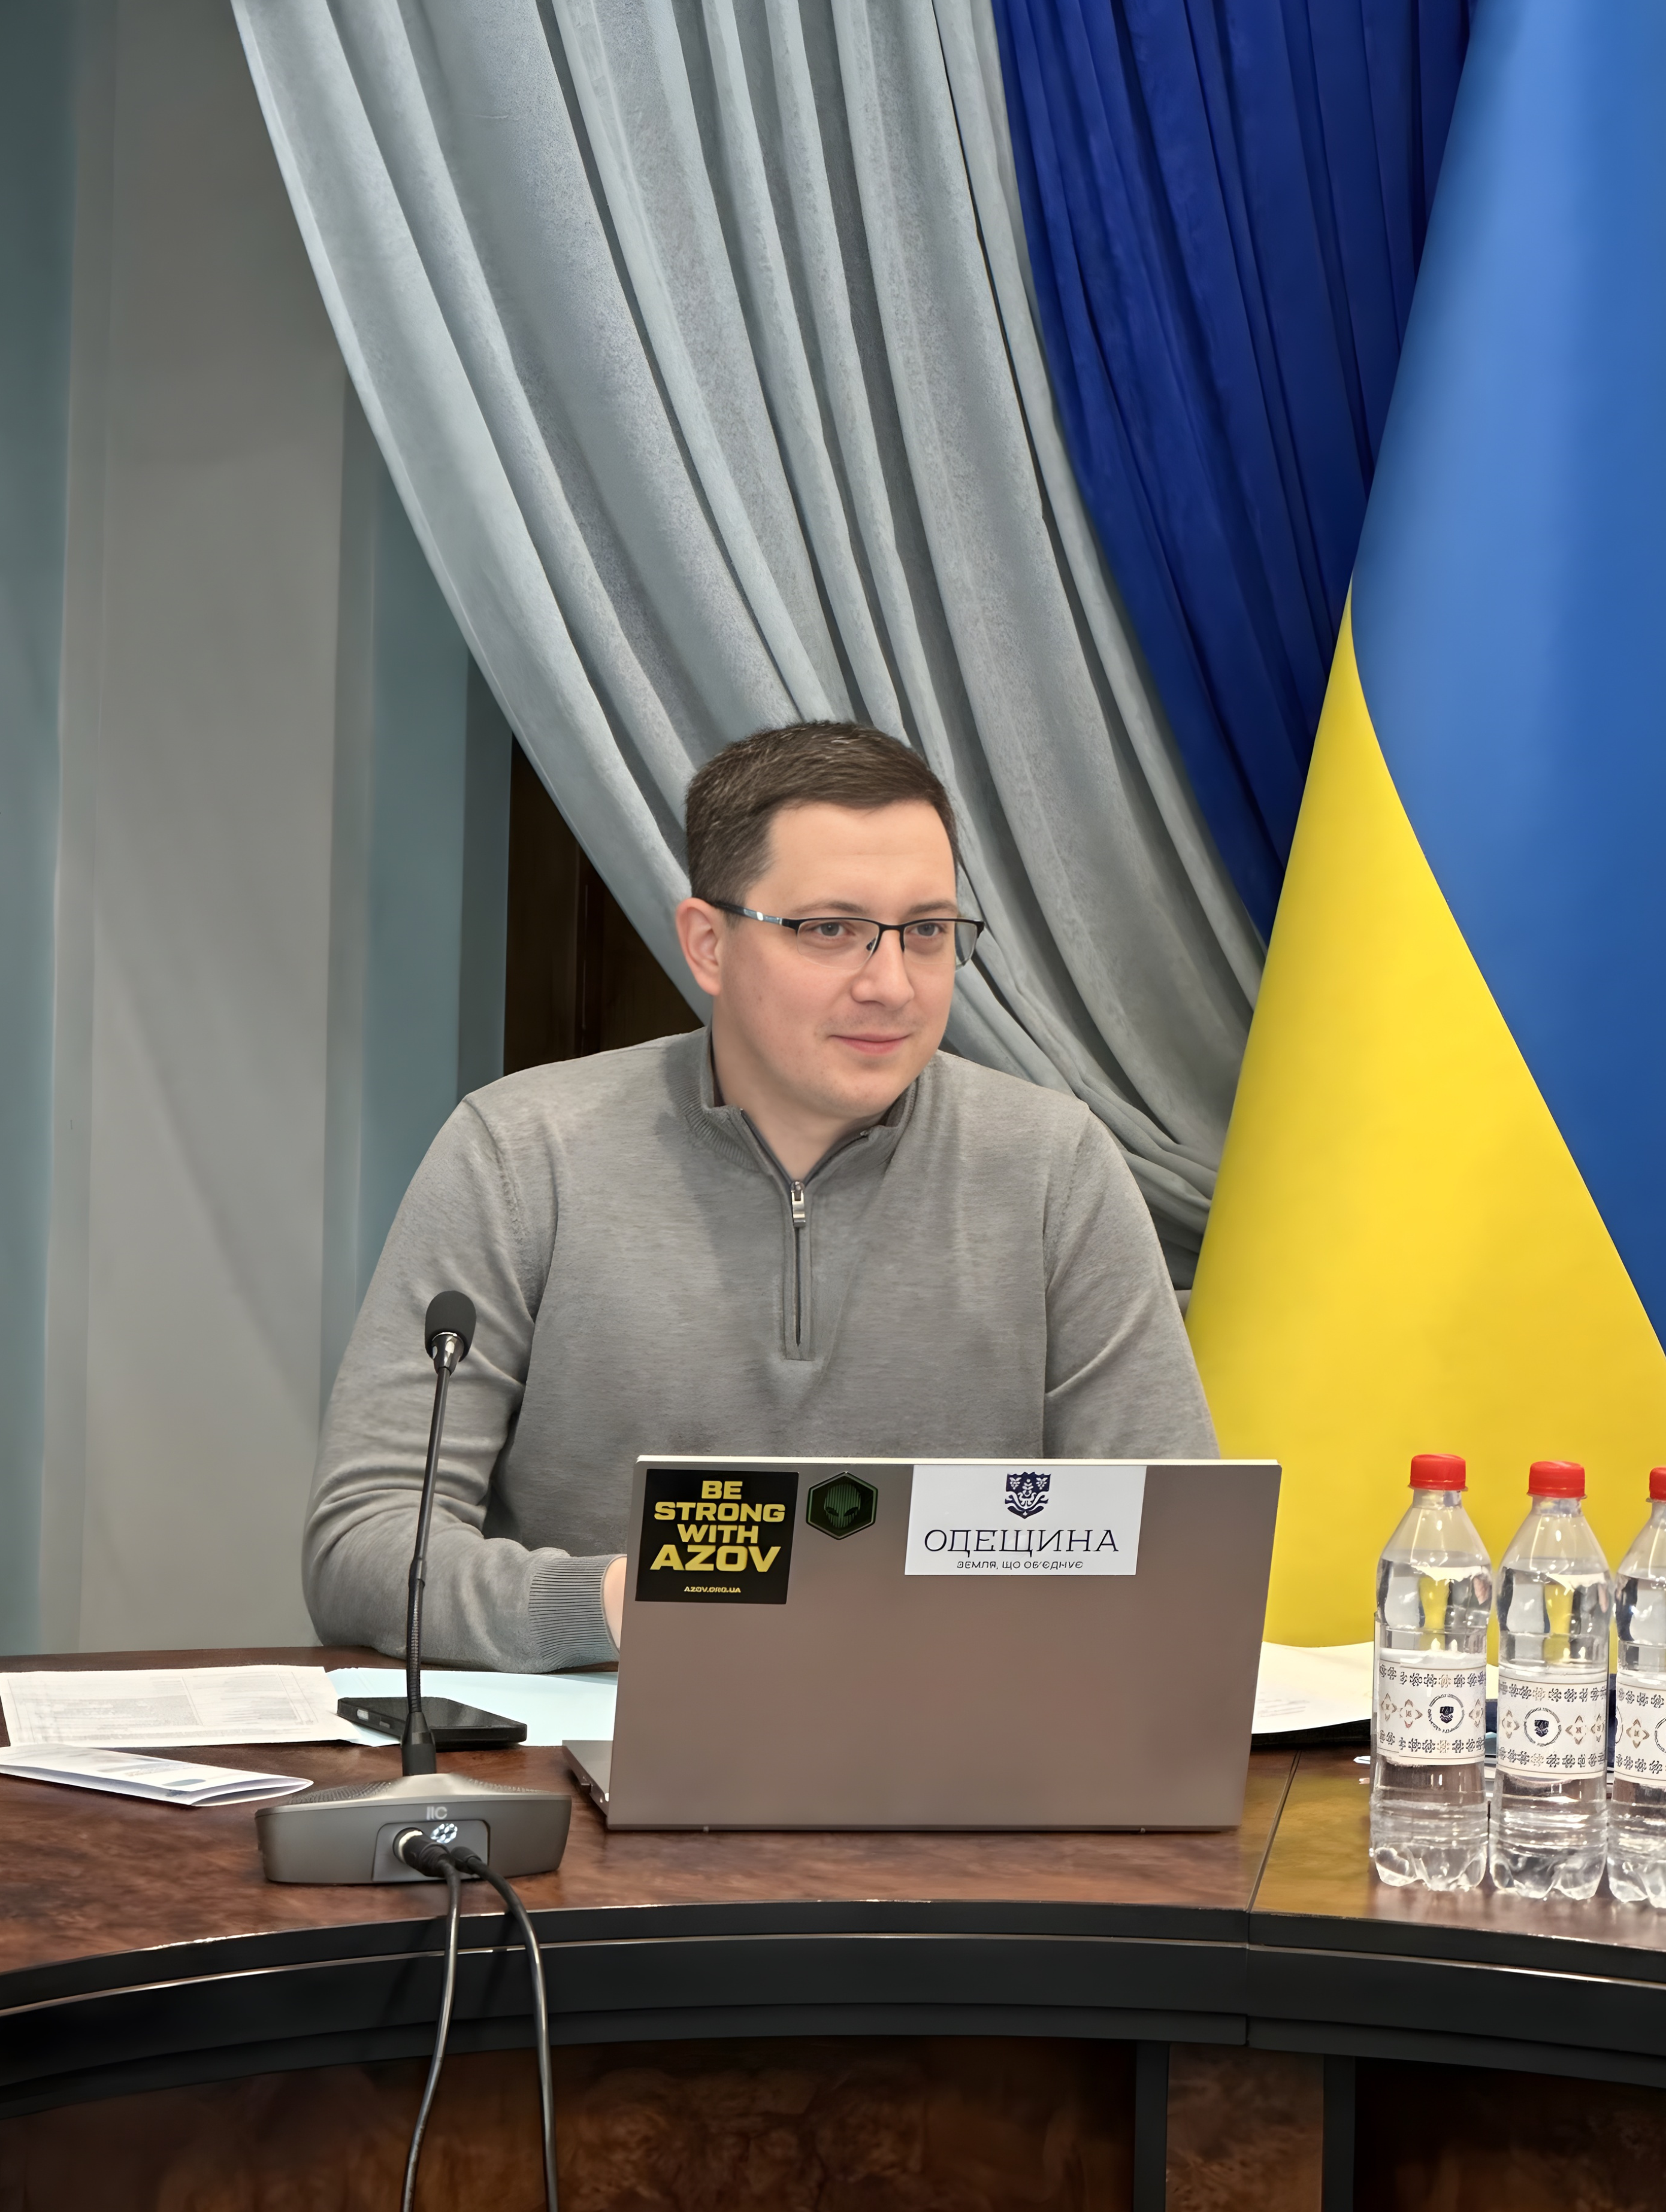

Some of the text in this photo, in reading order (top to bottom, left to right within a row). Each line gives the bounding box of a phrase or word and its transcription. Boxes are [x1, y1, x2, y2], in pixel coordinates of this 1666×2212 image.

[701, 1480, 743, 1500] BE
[654, 1501, 786, 1523] STRONG
[676, 1523, 759, 1544] WITH
[924, 1529, 1119, 1558] ОДЕЩИНА
[649, 1544, 782, 1572] AZOV
